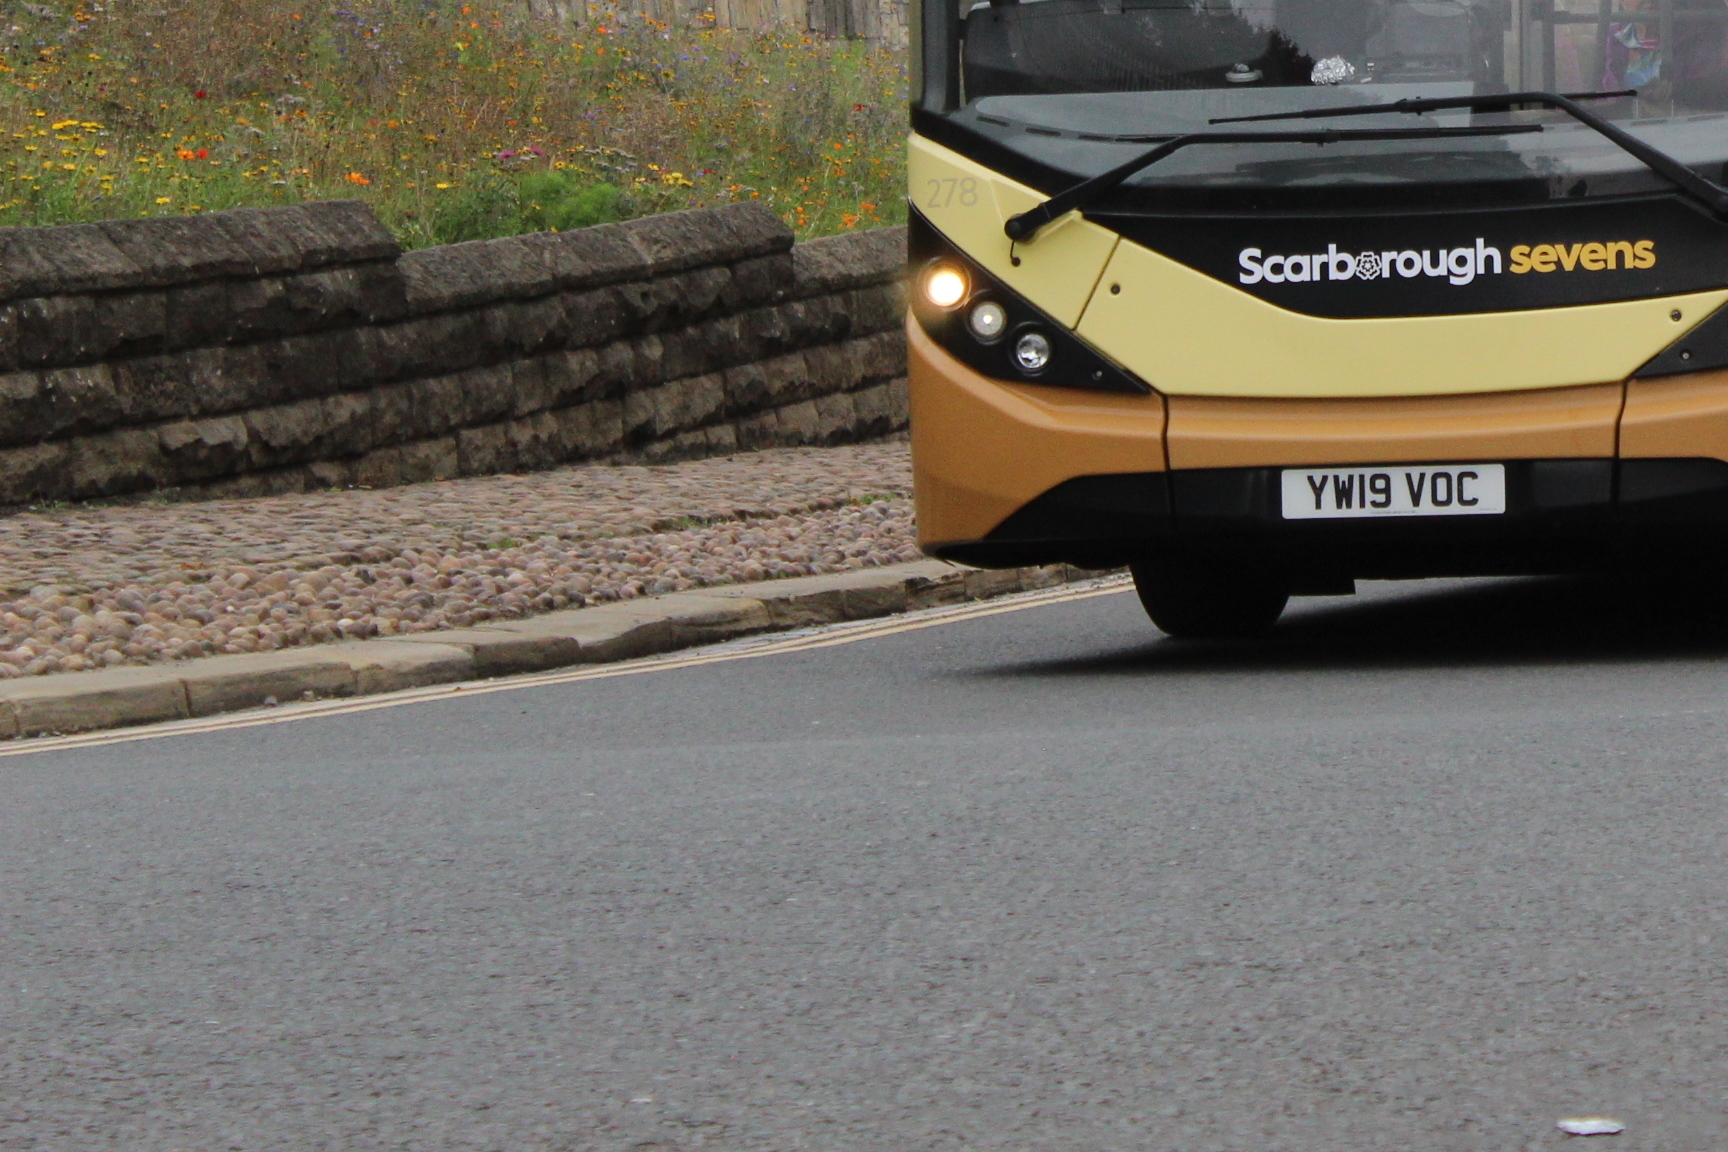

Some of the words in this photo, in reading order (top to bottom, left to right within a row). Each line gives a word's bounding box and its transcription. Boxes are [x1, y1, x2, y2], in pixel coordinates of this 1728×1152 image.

[927, 177, 977, 208] 278
[1238, 238, 1502, 286] Scarborough
[1509, 238, 1657, 275] sevens
[1307, 473, 1392, 511] YW19
[1405, 471, 1479, 508] VOC
